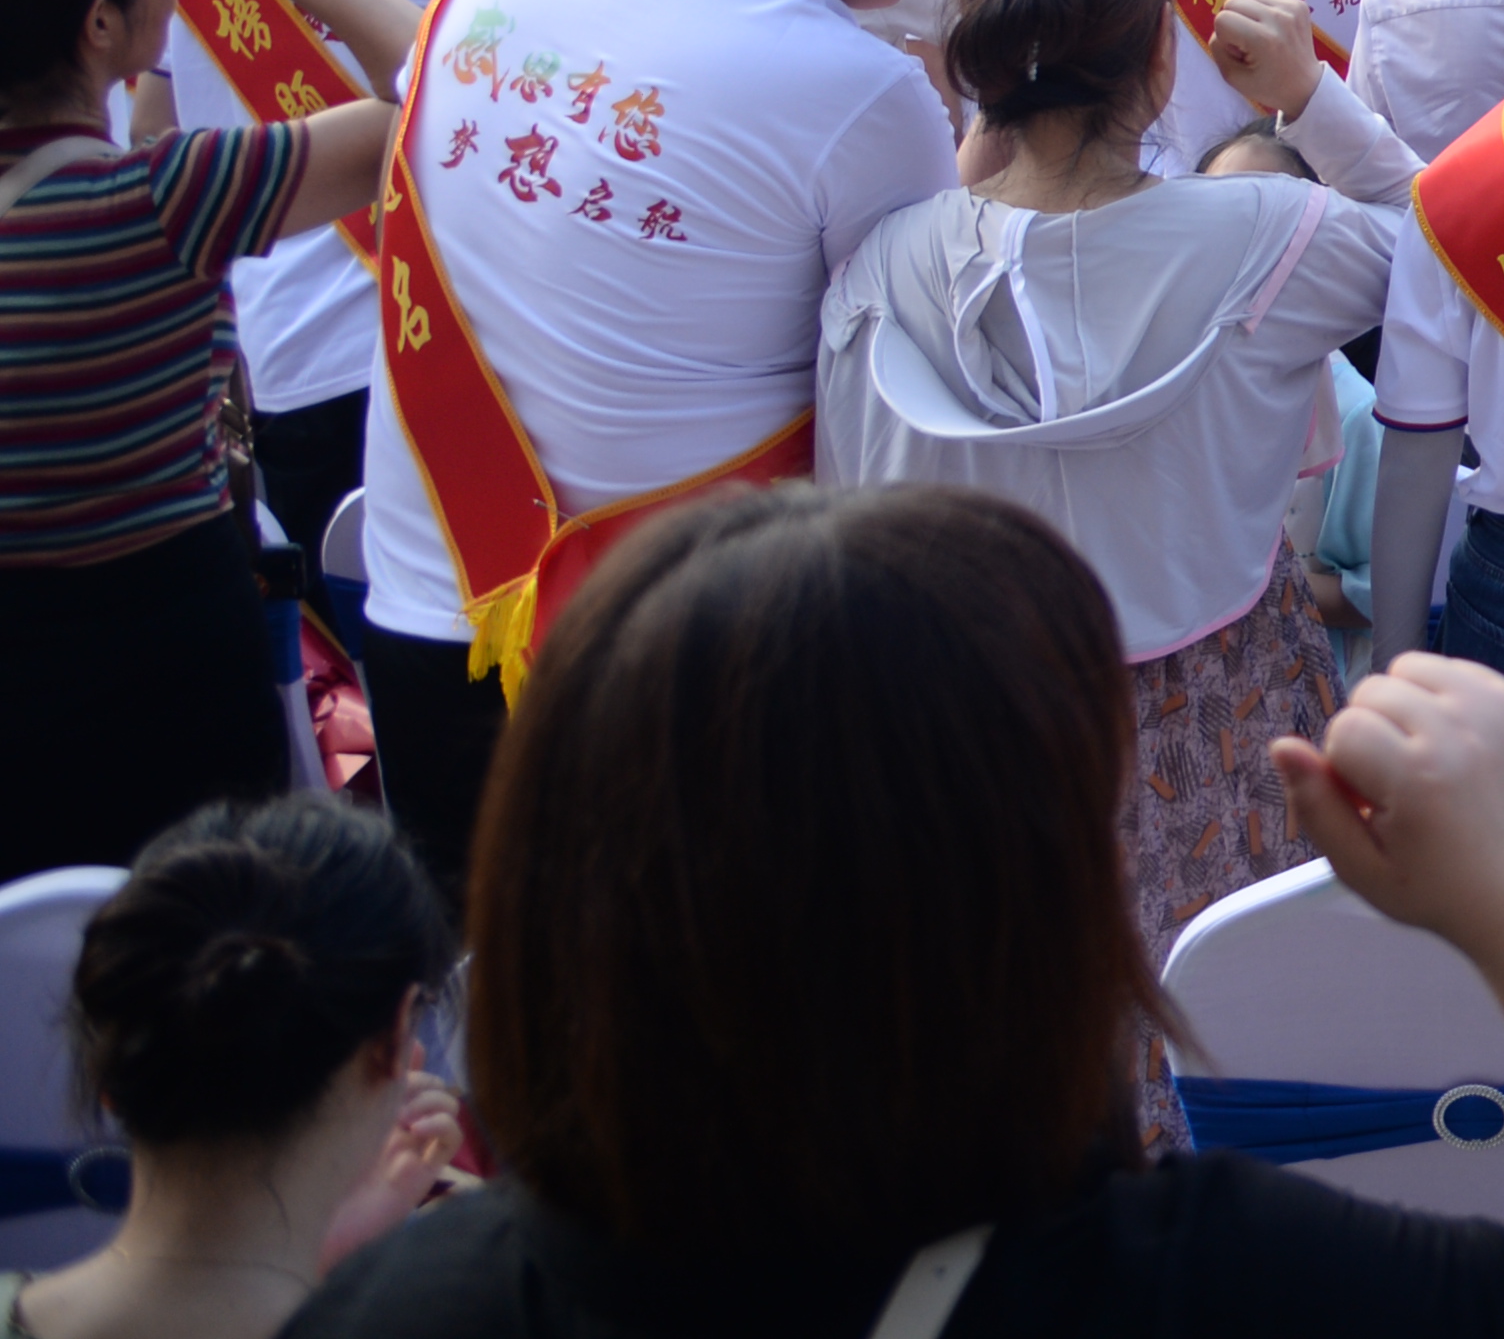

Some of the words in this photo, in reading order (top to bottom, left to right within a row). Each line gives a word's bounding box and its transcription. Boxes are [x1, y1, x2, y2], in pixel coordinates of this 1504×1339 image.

[443, 0, 666, 162] 感恩有您
[440, 118, 688, 243] 梦想启航
